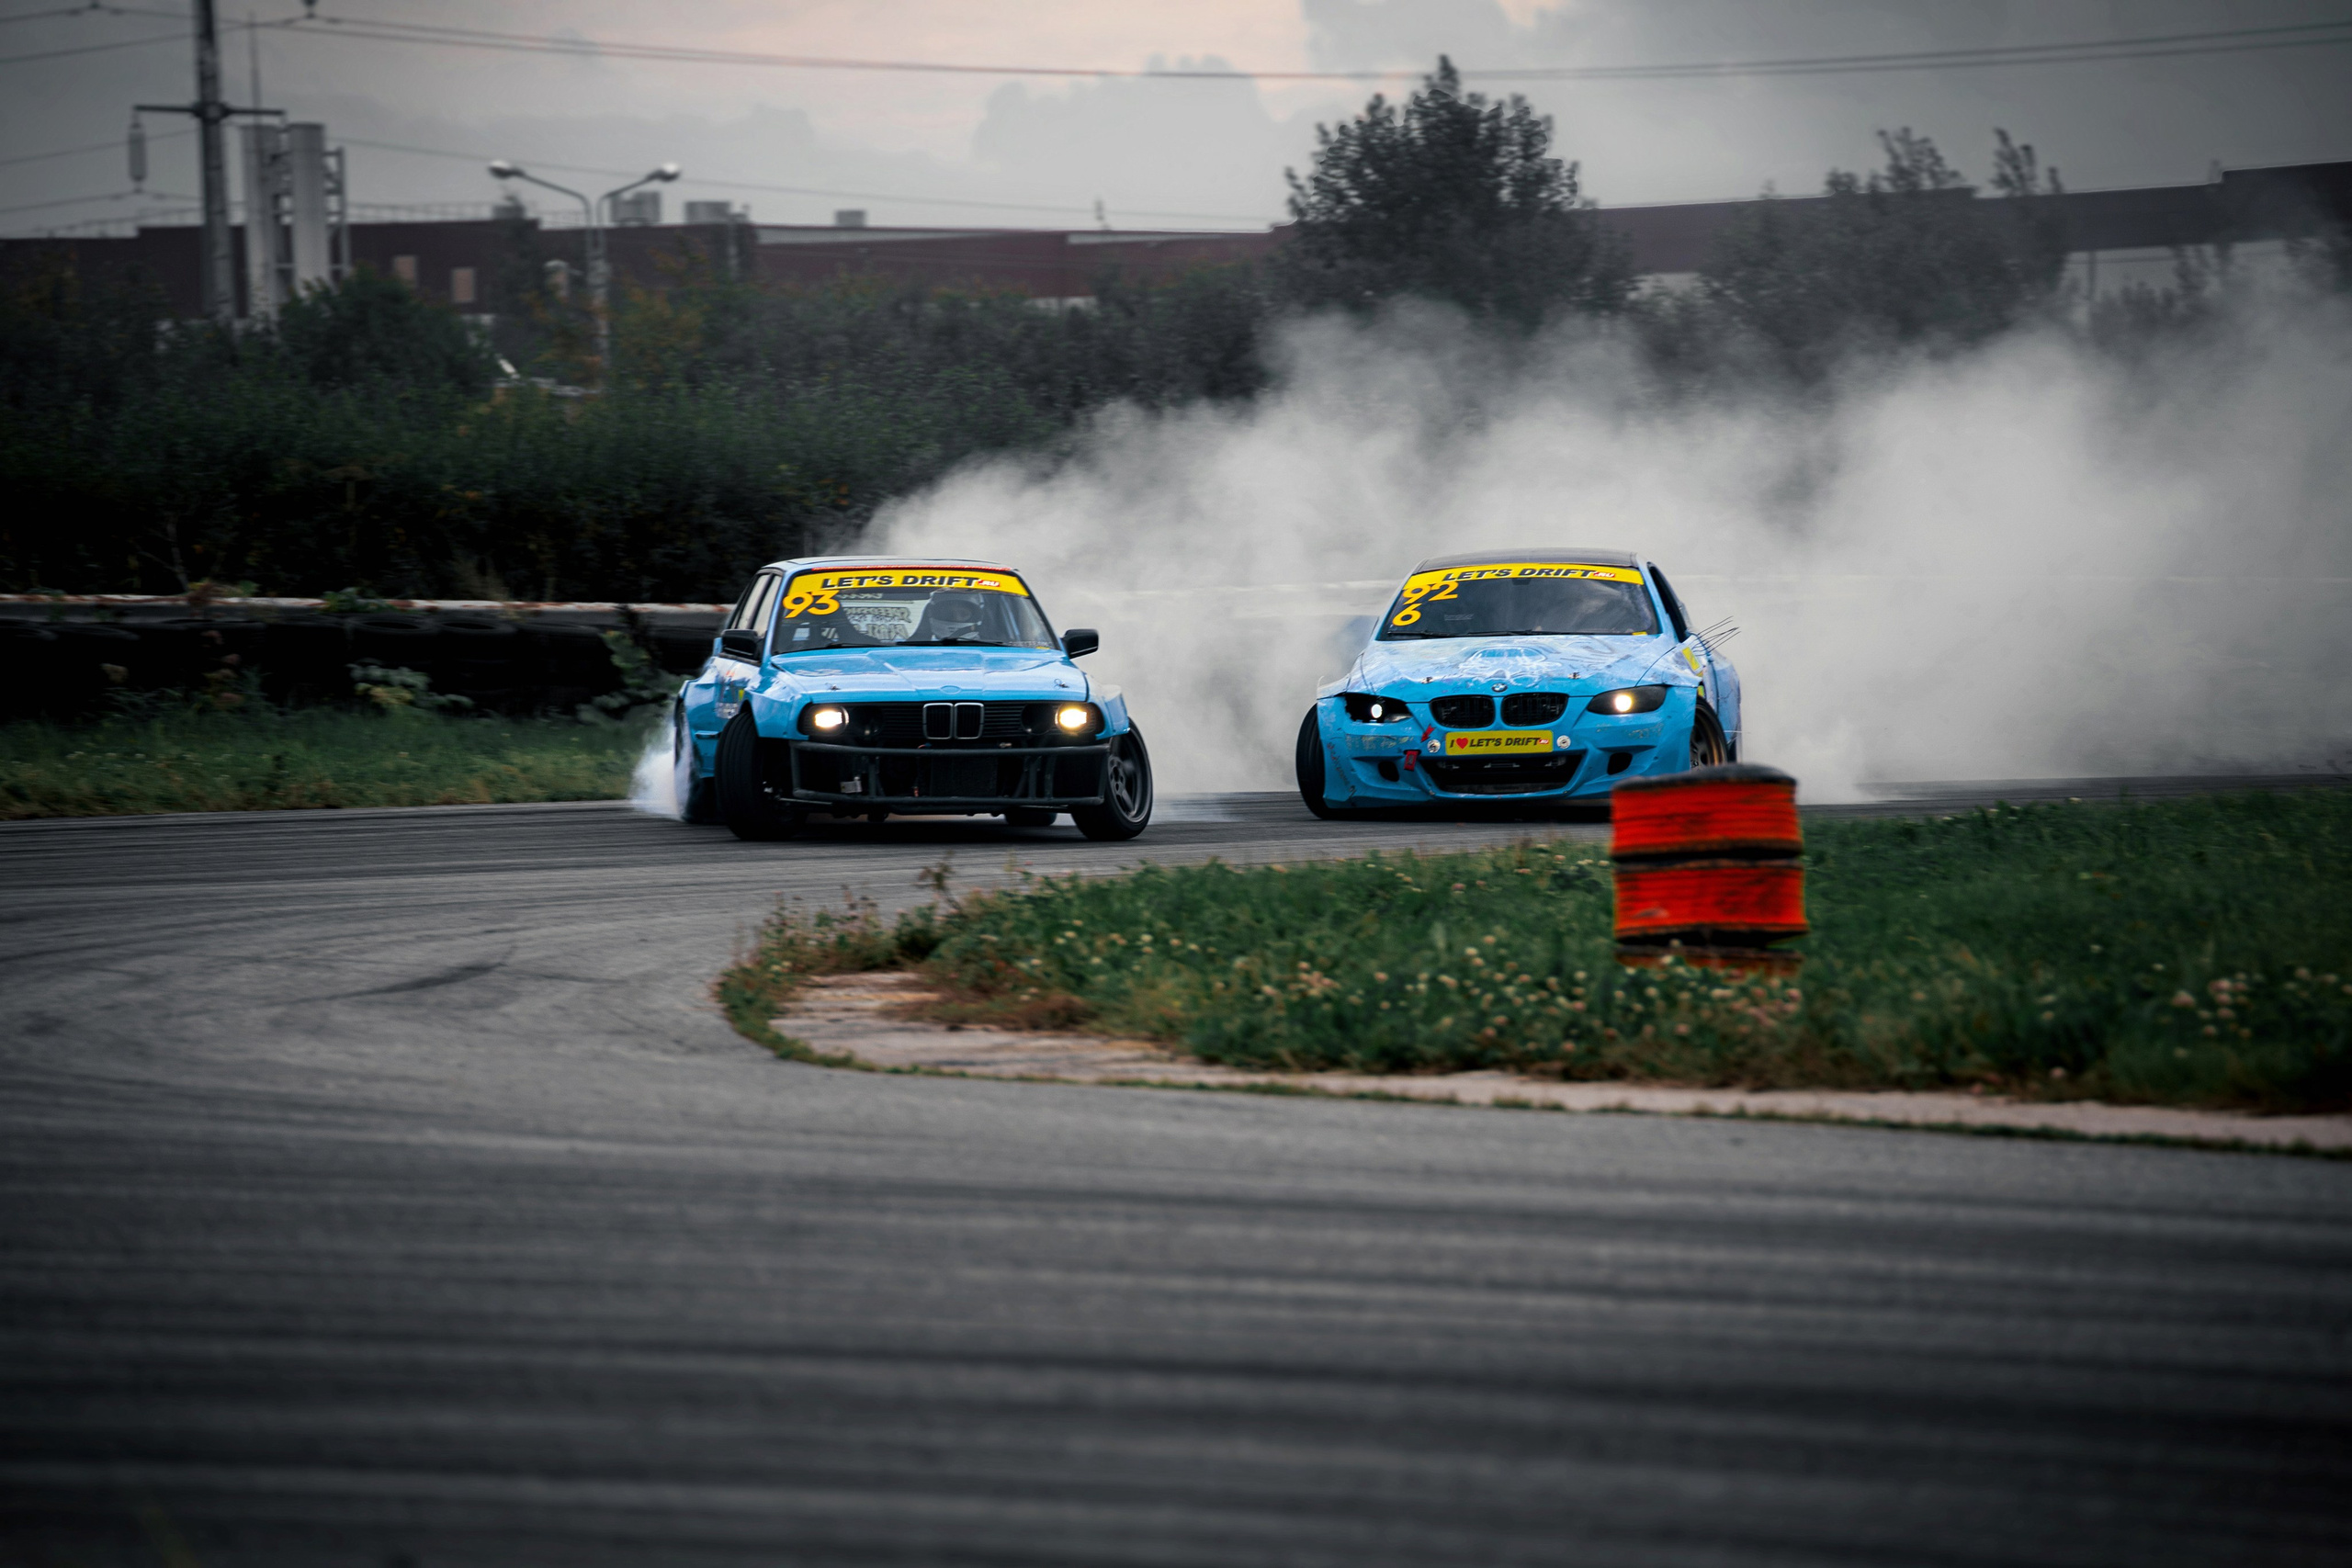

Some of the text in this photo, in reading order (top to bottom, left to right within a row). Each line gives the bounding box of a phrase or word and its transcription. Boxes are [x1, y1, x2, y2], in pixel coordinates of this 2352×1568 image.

[821, 575, 895, 589] LET'S
[1442, 569, 1512, 581] LET'S
[1402, 581, 1459, 605] 92
[782, 590, 840, 619] 93
[1392, 603, 1422, 626] 6
[1450, 739, 1454, 748] I
[1469, 738, 1502, 747] LET'S
